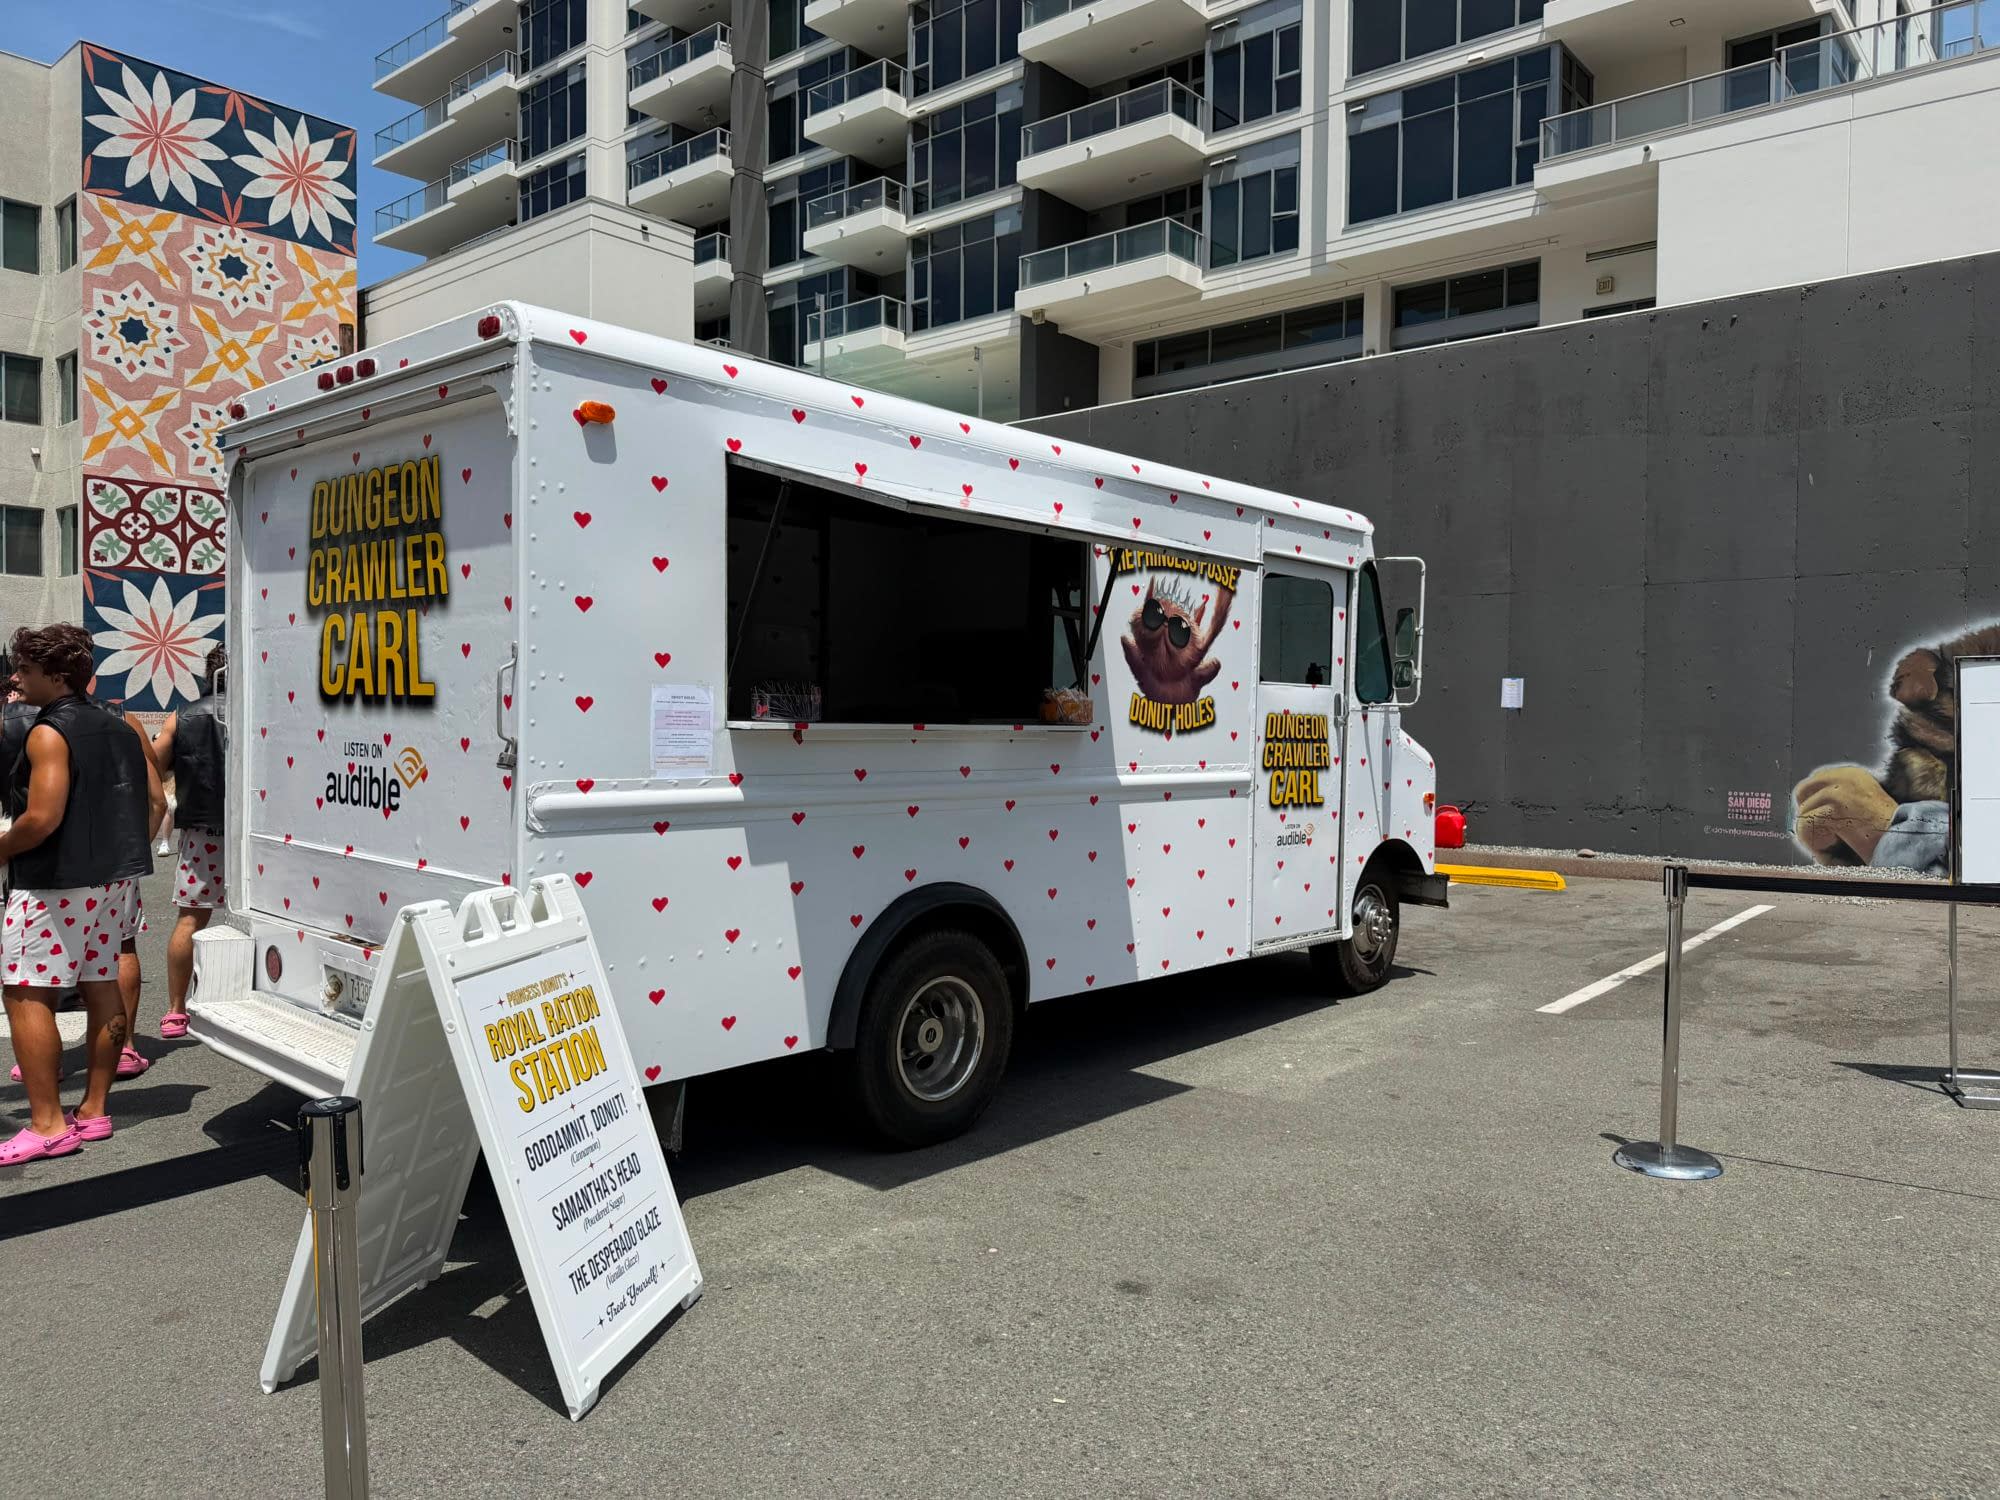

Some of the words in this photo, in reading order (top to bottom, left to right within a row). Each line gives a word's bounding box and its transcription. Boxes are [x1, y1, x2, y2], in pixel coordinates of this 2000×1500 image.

[311, 454, 442, 540] DUNGEON
[308, 532, 449, 607] CRAWLER
[321, 608, 436, 697] CARL
[1129, 692, 1173, 730] DONUT
[1175, 696, 1215, 730] HOLES
[1266, 712, 1328, 740] DUNGEON
[344, 742, 369, 758] LISTEN
[371, 743, 383, 758] ON
[1263, 742, 1330, 768] CRAWLER
[325, 765, 400, 812] audible
[1270, 770, 1325, 806] CARL
[1728, 797, 1745, 808] SAN
[1747, 797, 1771, 809] DIEGO
[1277, 830, 1306, 847] audible
[484, 1007, 546, 1063] ROYAL
[541, 984, 601, 1037] RATION
[509, 1025, 607, 1113] STATION
[524, 1114, 594, 1172] GODDAMNIT,
[590, 1092, 628, 1131] DONUT!
[570, 1138, 601, 1167] (Cinnamon)
[552, 1168, 617, 1231] SAMANTHA'S
[614, 1152, 641, 1188] HEAD
[583, 1202, 609, 1233] (Powdered
[608, 1192, 626, 1213] Sugar)
[568, 1263, 591, 1295] THE
[587, 1226, 638, 1280] DESPERADO
[635, 1206, 662, 1241] GLAZE
[605, 1260, 626, 1289] (Vanilla
[623, 1251, 640, 1272] Glaze)
[606, 1295, 627, 1322] Treat
[626, 1264, 659, 1306] Yourself!
